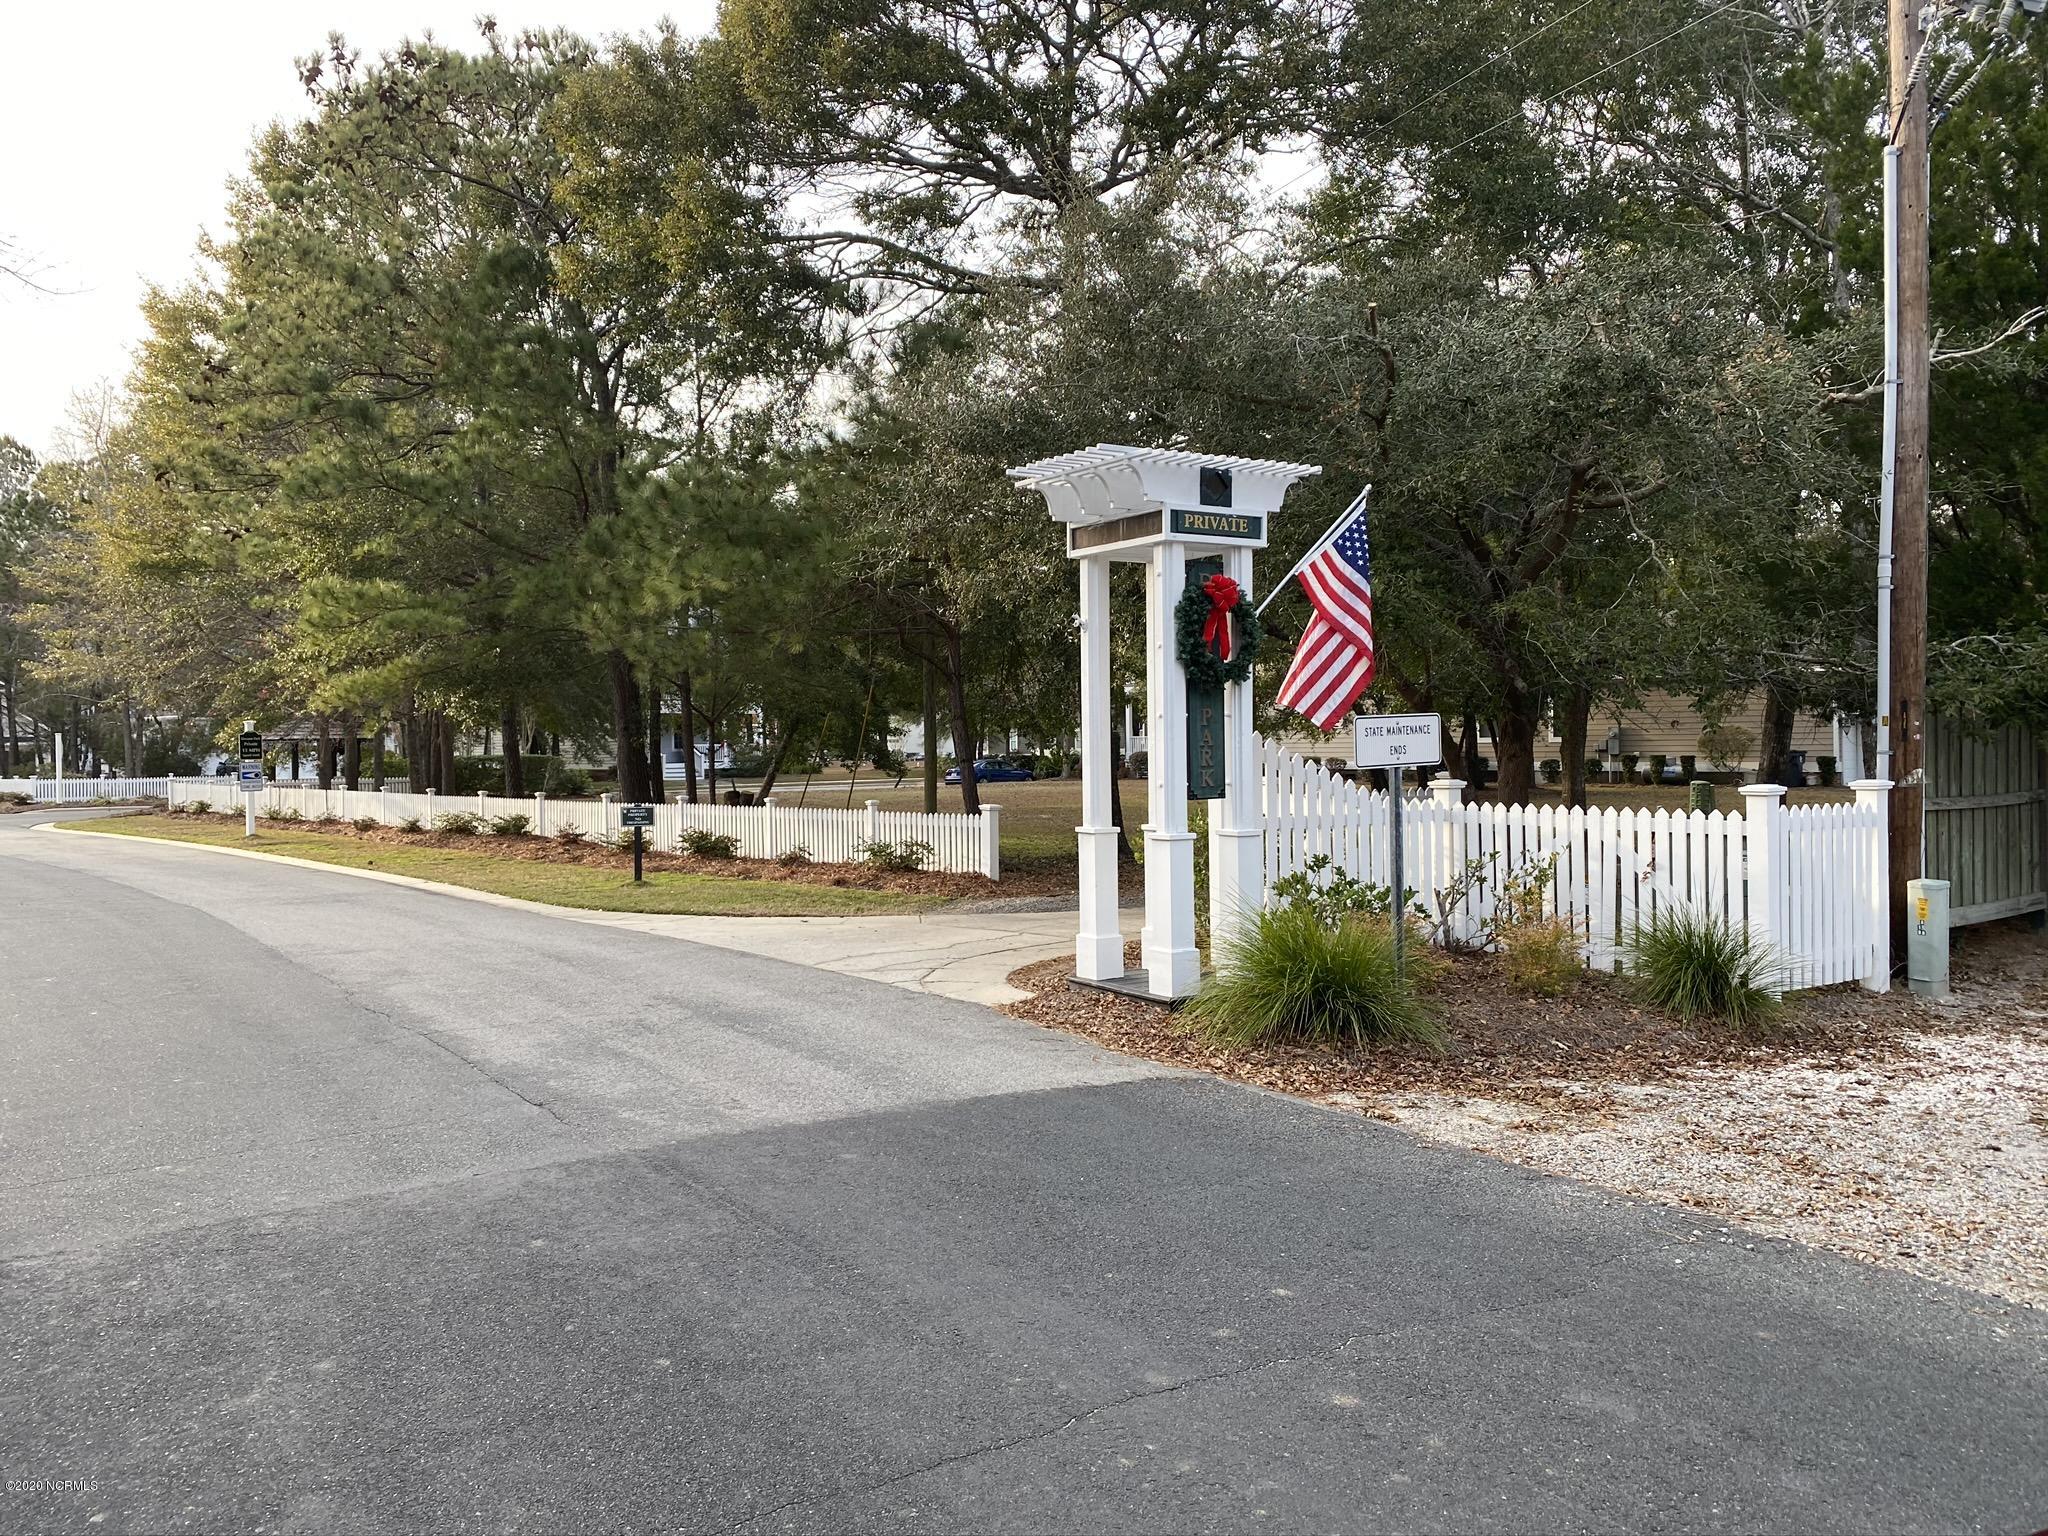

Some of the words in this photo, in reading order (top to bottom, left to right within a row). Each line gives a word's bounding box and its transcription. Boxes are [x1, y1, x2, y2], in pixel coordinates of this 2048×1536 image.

[1184, 513, 1248, 532] PRIVATE
[1364, 726, 1384, 737] STATE
[1386, 724, 1430, 736] MAINTENANCE
[1200, 708, 1215, 787] PARK
[1390, 744, 1406, 755] ENDS
